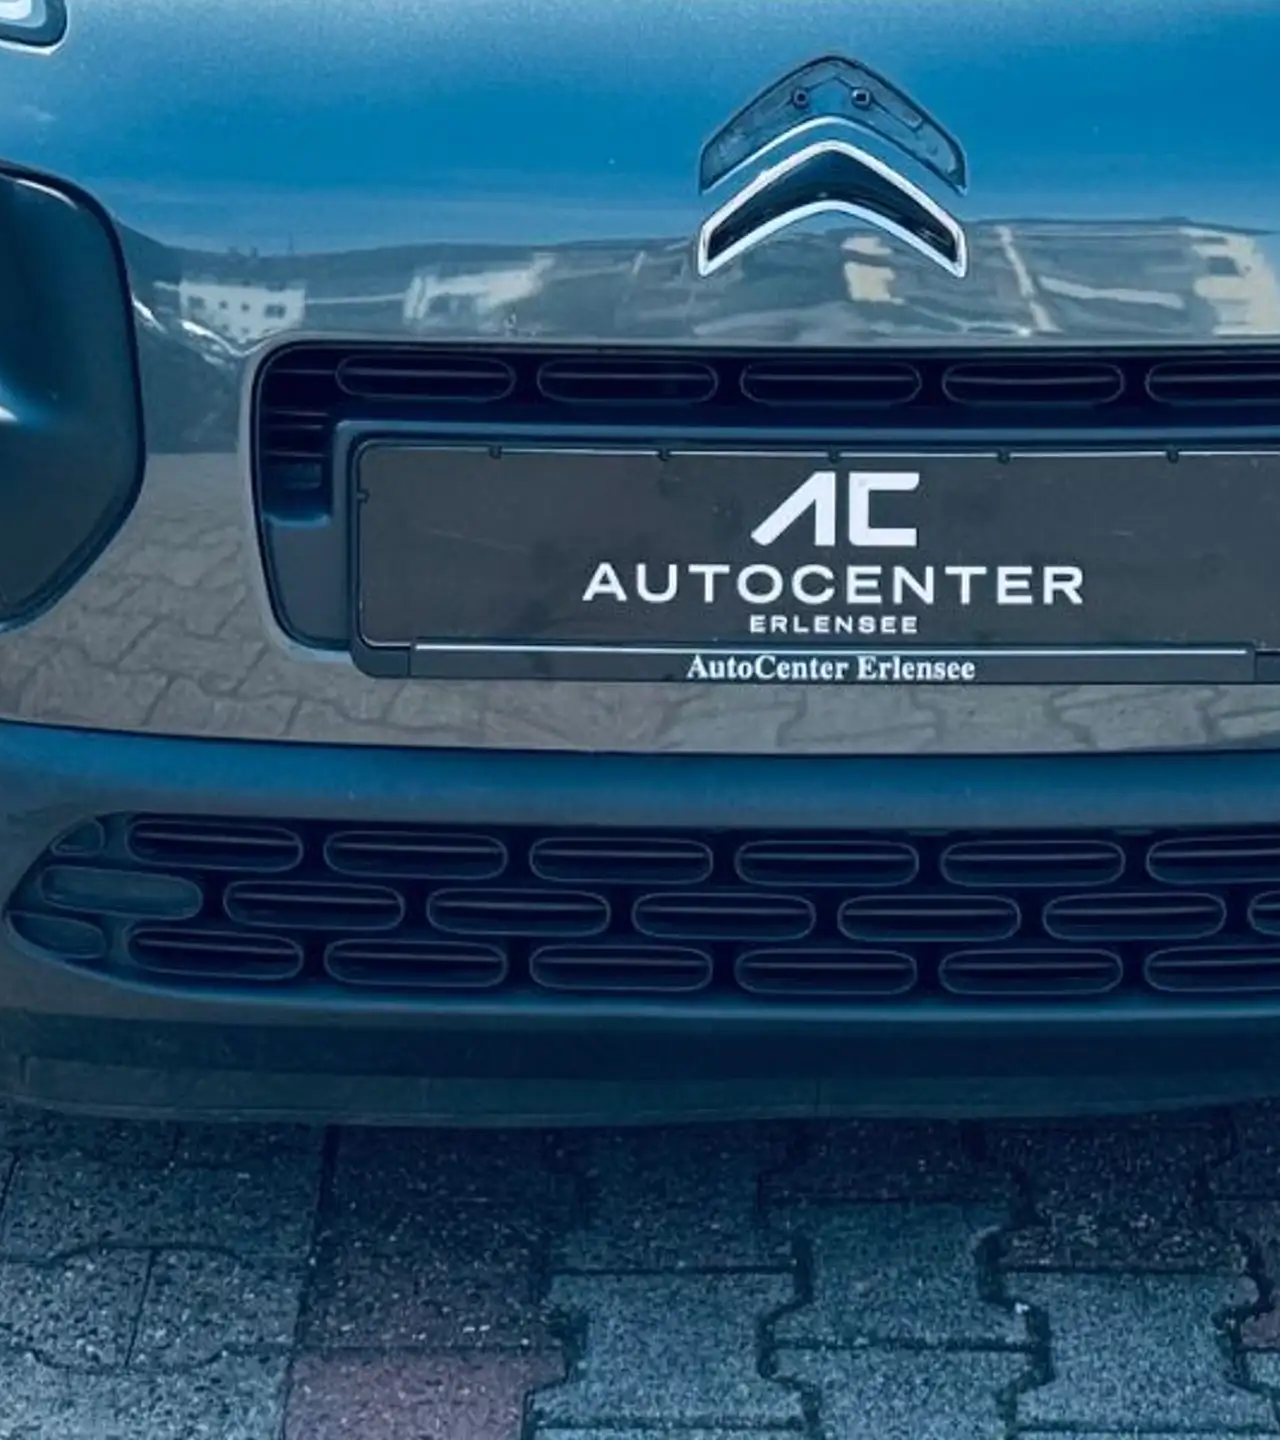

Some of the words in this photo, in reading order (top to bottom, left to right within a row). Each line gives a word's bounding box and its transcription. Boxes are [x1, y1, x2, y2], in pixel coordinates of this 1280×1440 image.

[750, 471, 920, 547] AC
[582, 562, 1083, 605] AUTOCENTER
[750, 614, 918, 634] ERLENSEE
[687, 654, 849, 680] AutoCenter
[856, 656, 976, 682] Erlensee
